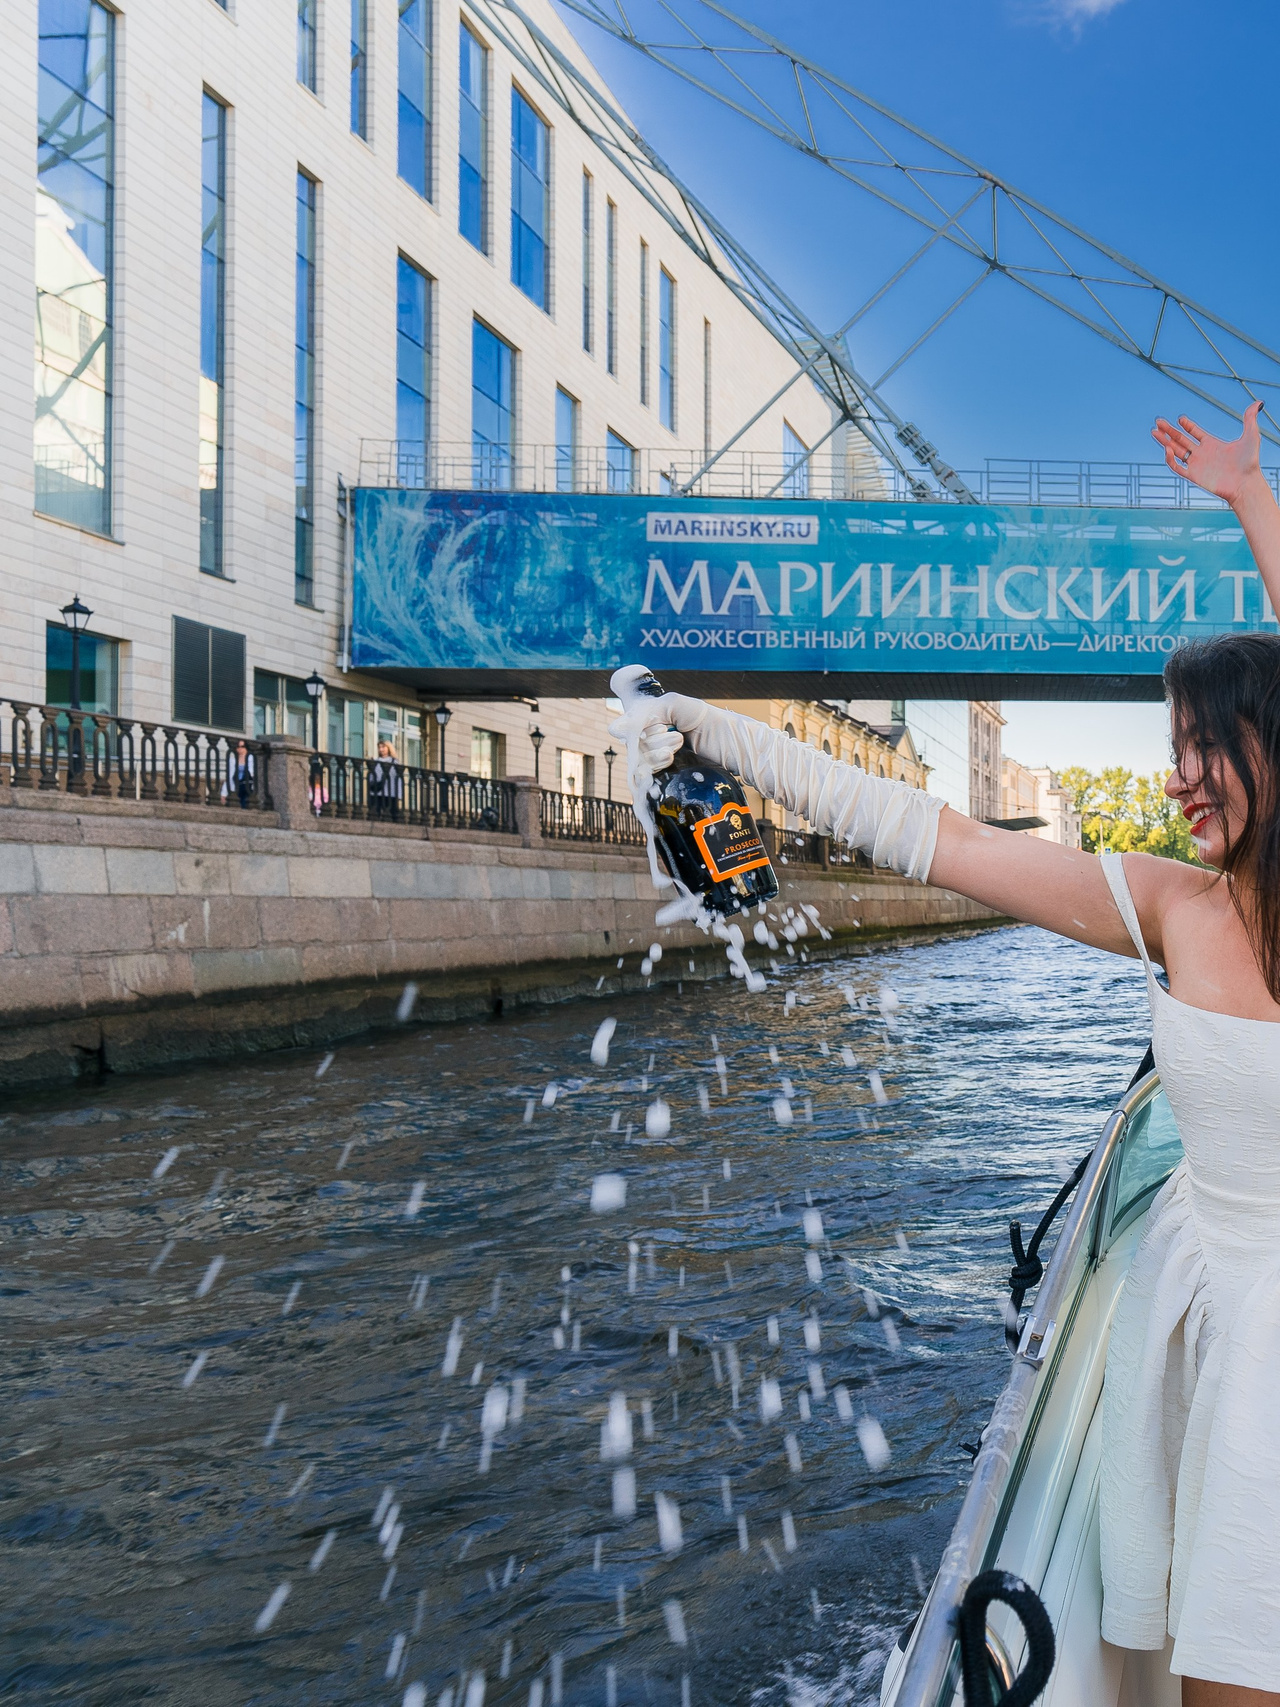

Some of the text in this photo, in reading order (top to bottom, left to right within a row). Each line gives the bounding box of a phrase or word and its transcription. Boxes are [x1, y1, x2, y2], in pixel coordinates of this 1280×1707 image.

[653, 519, 811, 538] MARIINSKY.RU
[639, 555, 1198, 622] МАРИИНСКИЙ
[639, 627, 866, 650] ХУДОЖЕСТВЕННЫЙ
[724, 838, 760, 855] PROSECCO
